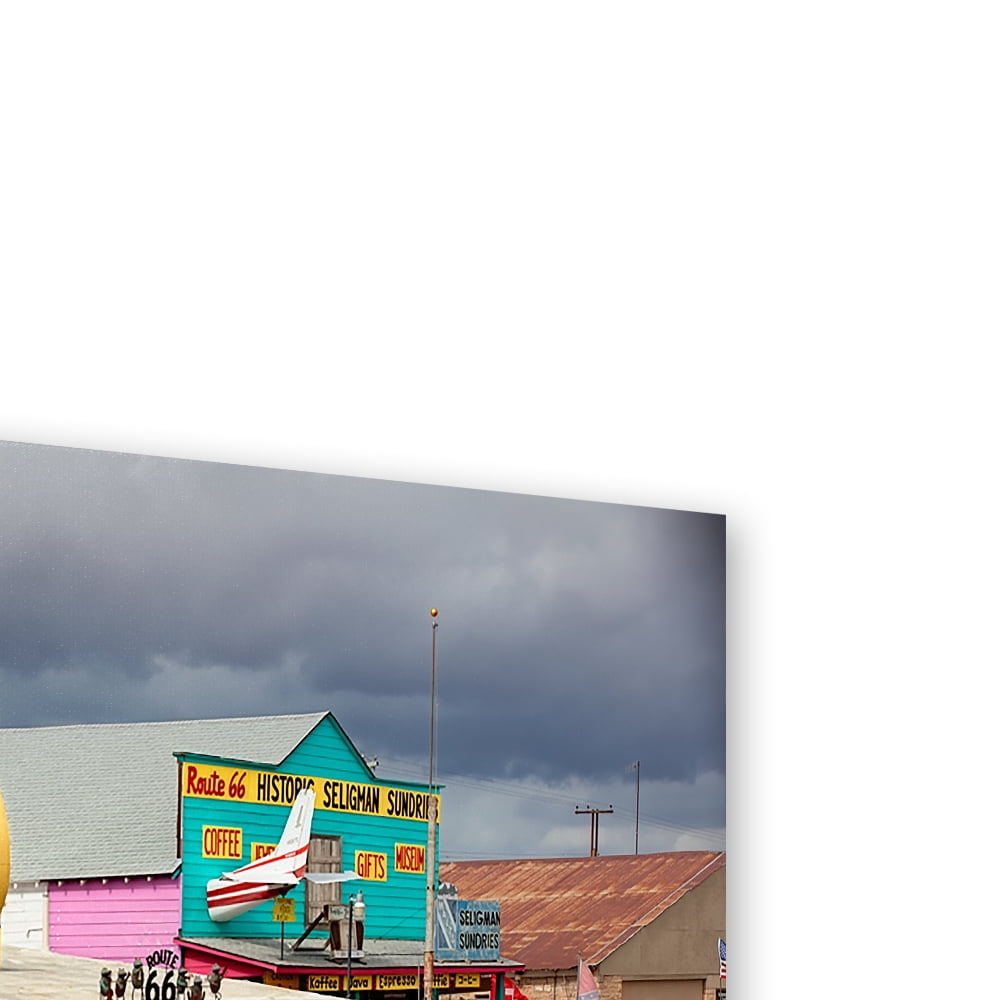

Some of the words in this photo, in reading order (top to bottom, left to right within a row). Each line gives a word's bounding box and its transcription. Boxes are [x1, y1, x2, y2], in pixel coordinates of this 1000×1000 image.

[187, 766, 225, 797] Route
[229, 771, 247, 799] 66
[323, 781, 380, 815] SELIGMAN
[387, 789, 439, 820] SUNDRI
[204, 828, 241, 857] COFFEE
[357, 853, 385, 879] GIFTS
[395, 845, 425, 872] MUSEUM
[459, 910, 500, 926] SELIGMAN
[459, 932, 499, 949] SUNDRIES
[146, 949, 179, 970] ROUTE
[380, 975, 416, 989] Espresso
